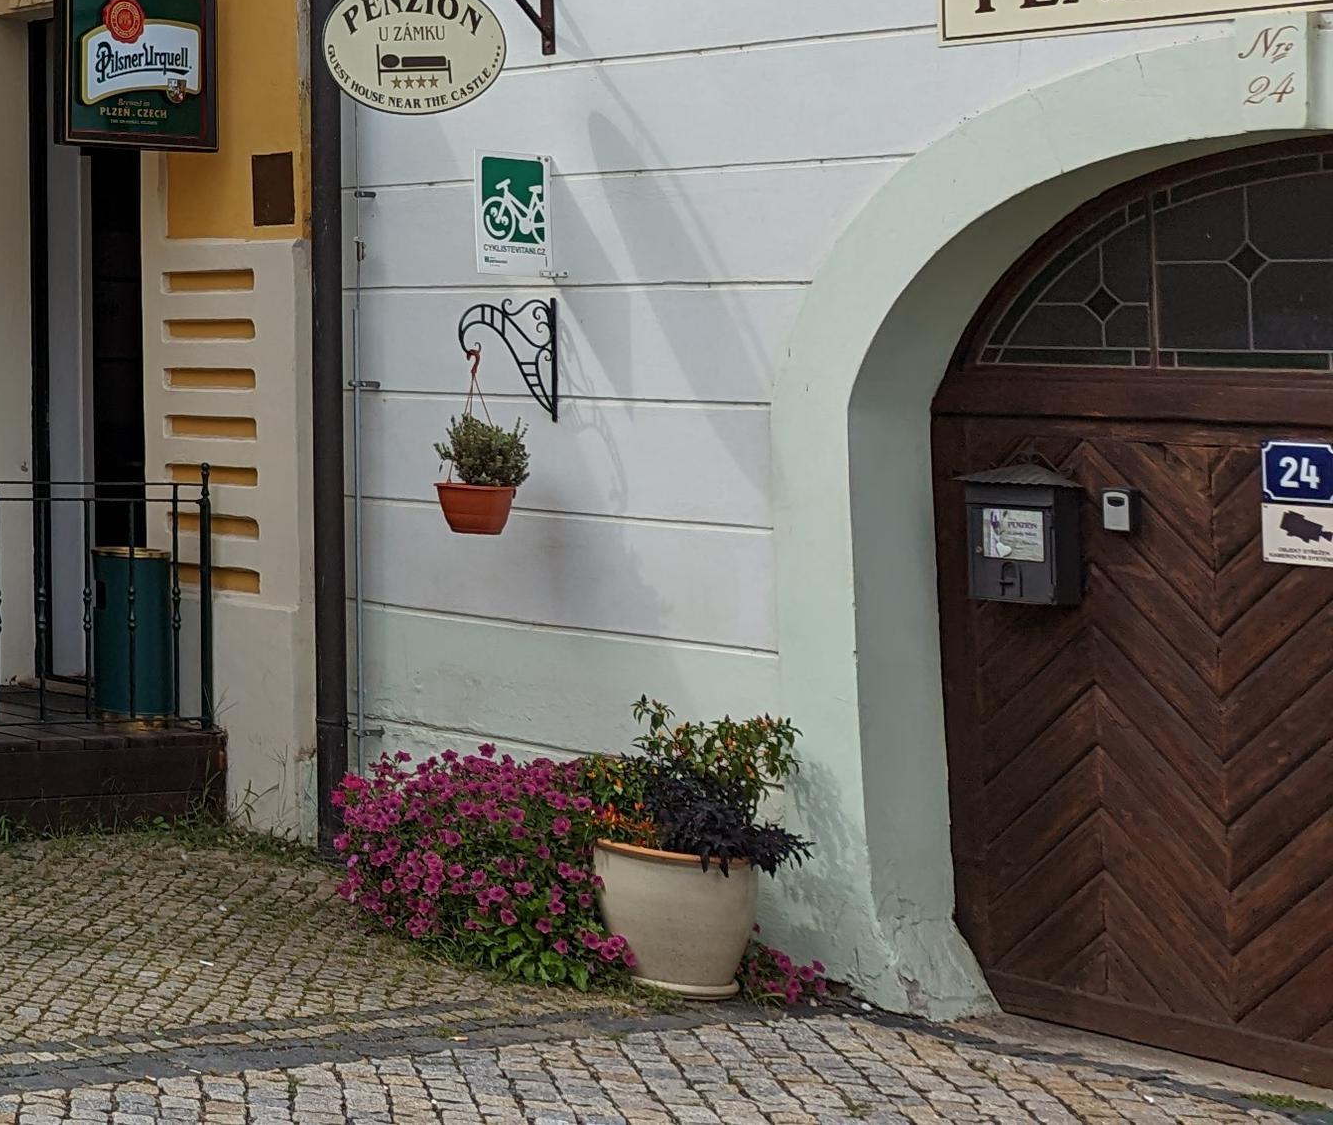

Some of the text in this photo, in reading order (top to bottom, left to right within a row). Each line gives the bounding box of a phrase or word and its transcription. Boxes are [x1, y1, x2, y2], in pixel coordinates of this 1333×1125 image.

[379, 22, 446, 42] U ZÁMKU
[95, 41, 190, 84] Pilsner Urquell
[327, 44, 492, 109] GUEST HOUSE NEAR THE CASTLE
[1243, 72, 1295, 105] 24
[137, 108, 167, 119] CZECH
[1278, 456, 1321, 490] 24
